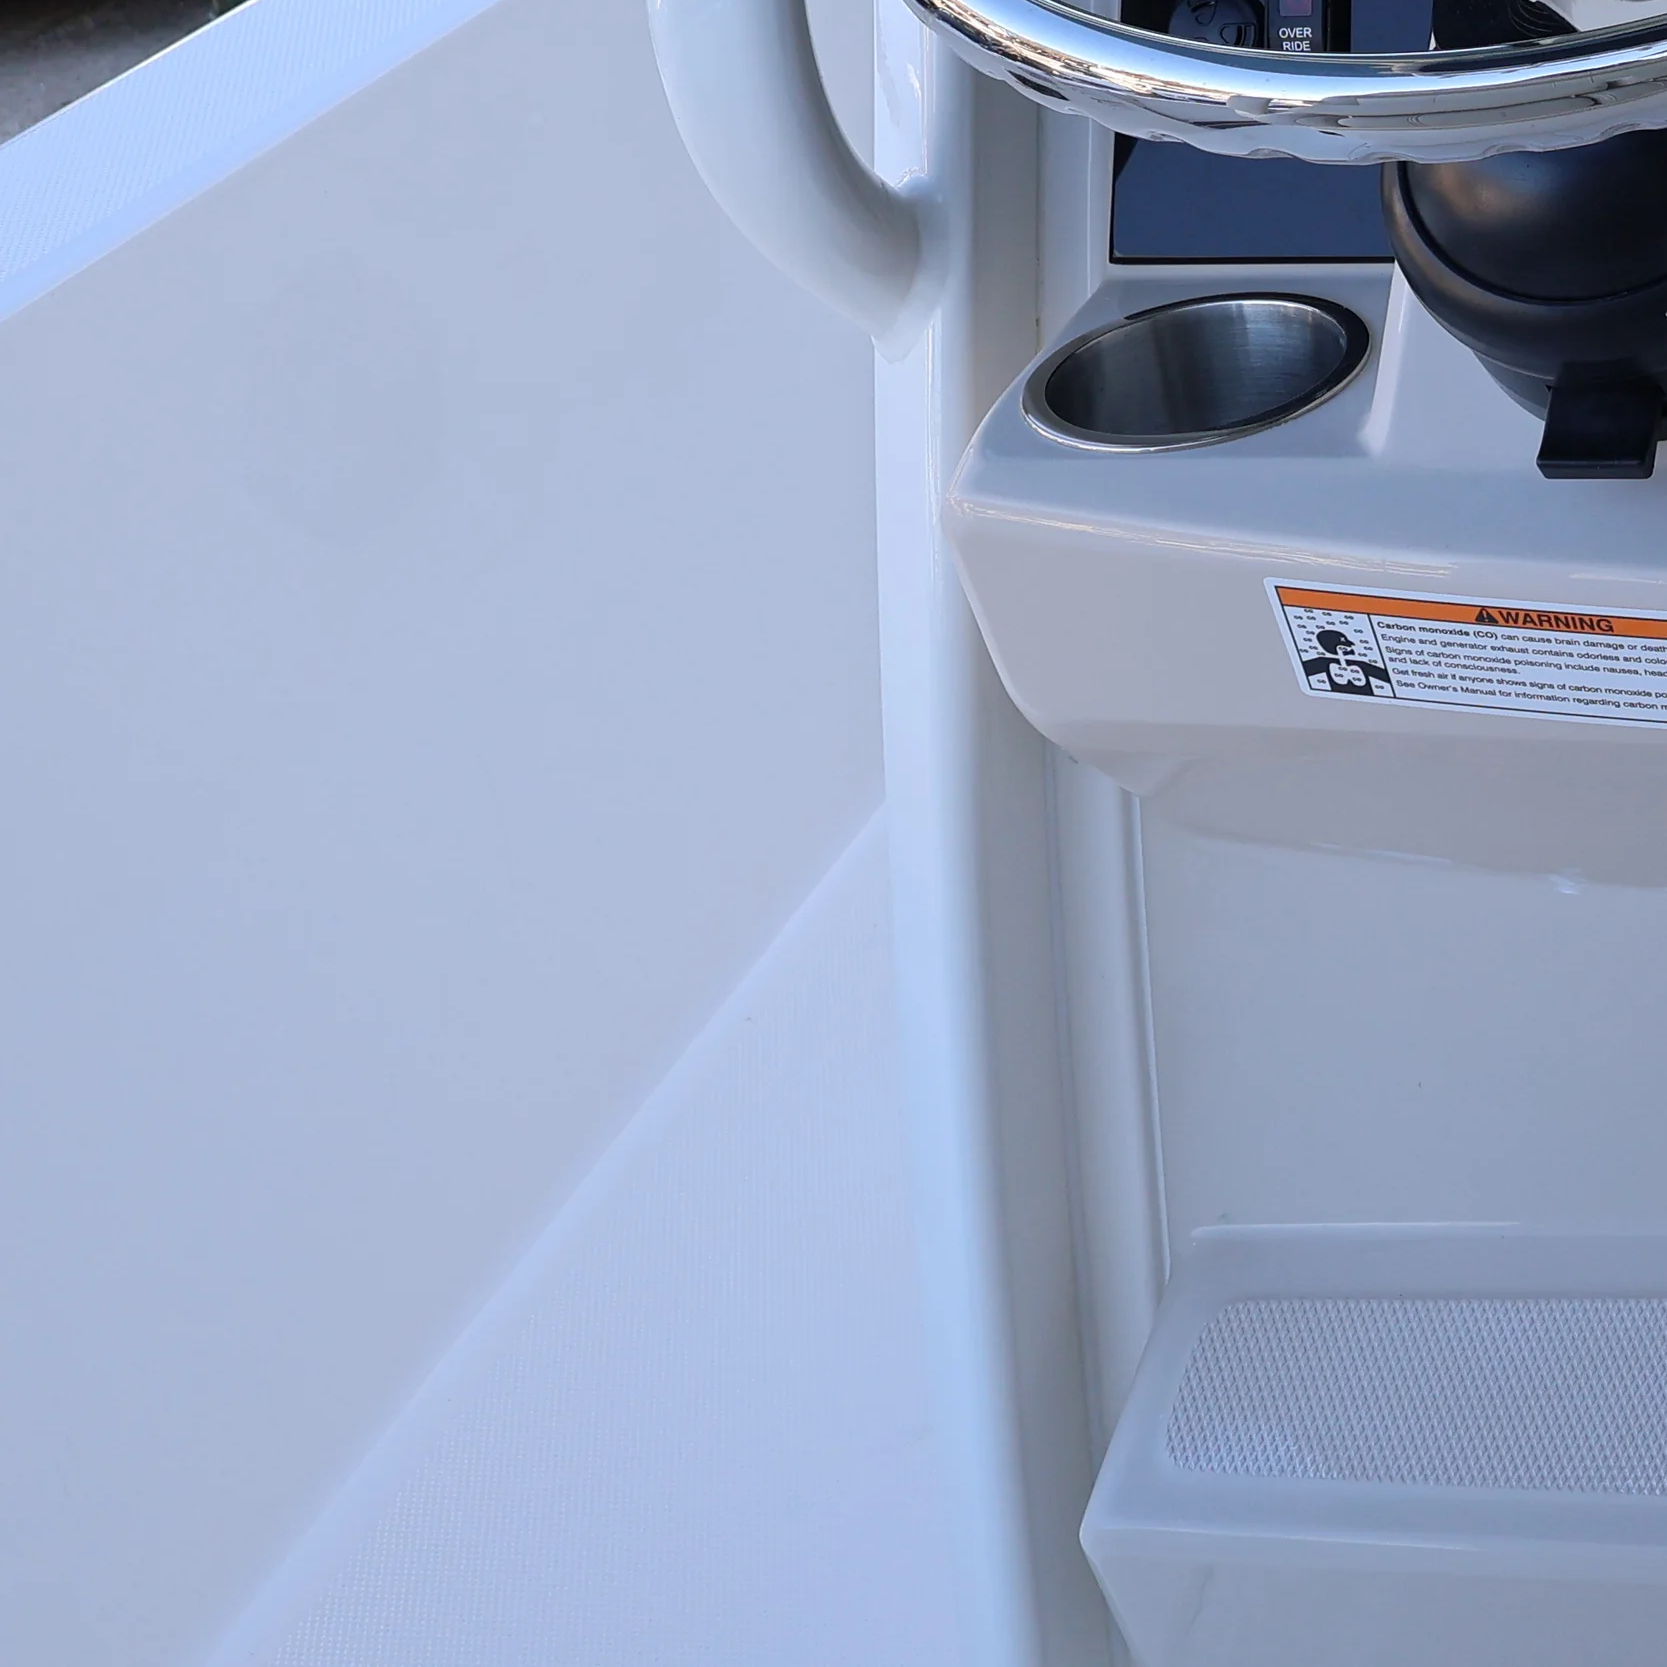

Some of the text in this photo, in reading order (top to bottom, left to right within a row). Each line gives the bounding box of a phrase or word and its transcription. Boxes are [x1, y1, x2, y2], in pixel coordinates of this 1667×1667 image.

[1278, 27, 1313, 39] OVER
[1282, 41, 1311, 52] RIDE
[1497, 610, 1614, 632] WARNING
[1376, 621, 1416, 631] Carbon
[1418, 626, 1470, 636] monoxide
[1472, 630, 1498, 640] (CO)
[1521, 635, 1552, 643] cause
[1553, 637, 1580, 646] brain
[1582, 639, 1624, 650] damage
[1380, 633, 1416, 643] Engine
[1439, 640, 1487, 650] generator
[1489, 645, 1529, 654] exhaust
[1531, 648, 1574, 657] contains
[1576, 651, 1620, 661] odorless
[1622, 655, 1642, 663] and
[1384, 645, 1412, 655] Signs
[1426, 651, 1461, 659] carbon
[1462, 654, 1511, 664] monoxide
[1513, 659, 1562, 670] poisoning
[1563, 662, 1600, 672] include
